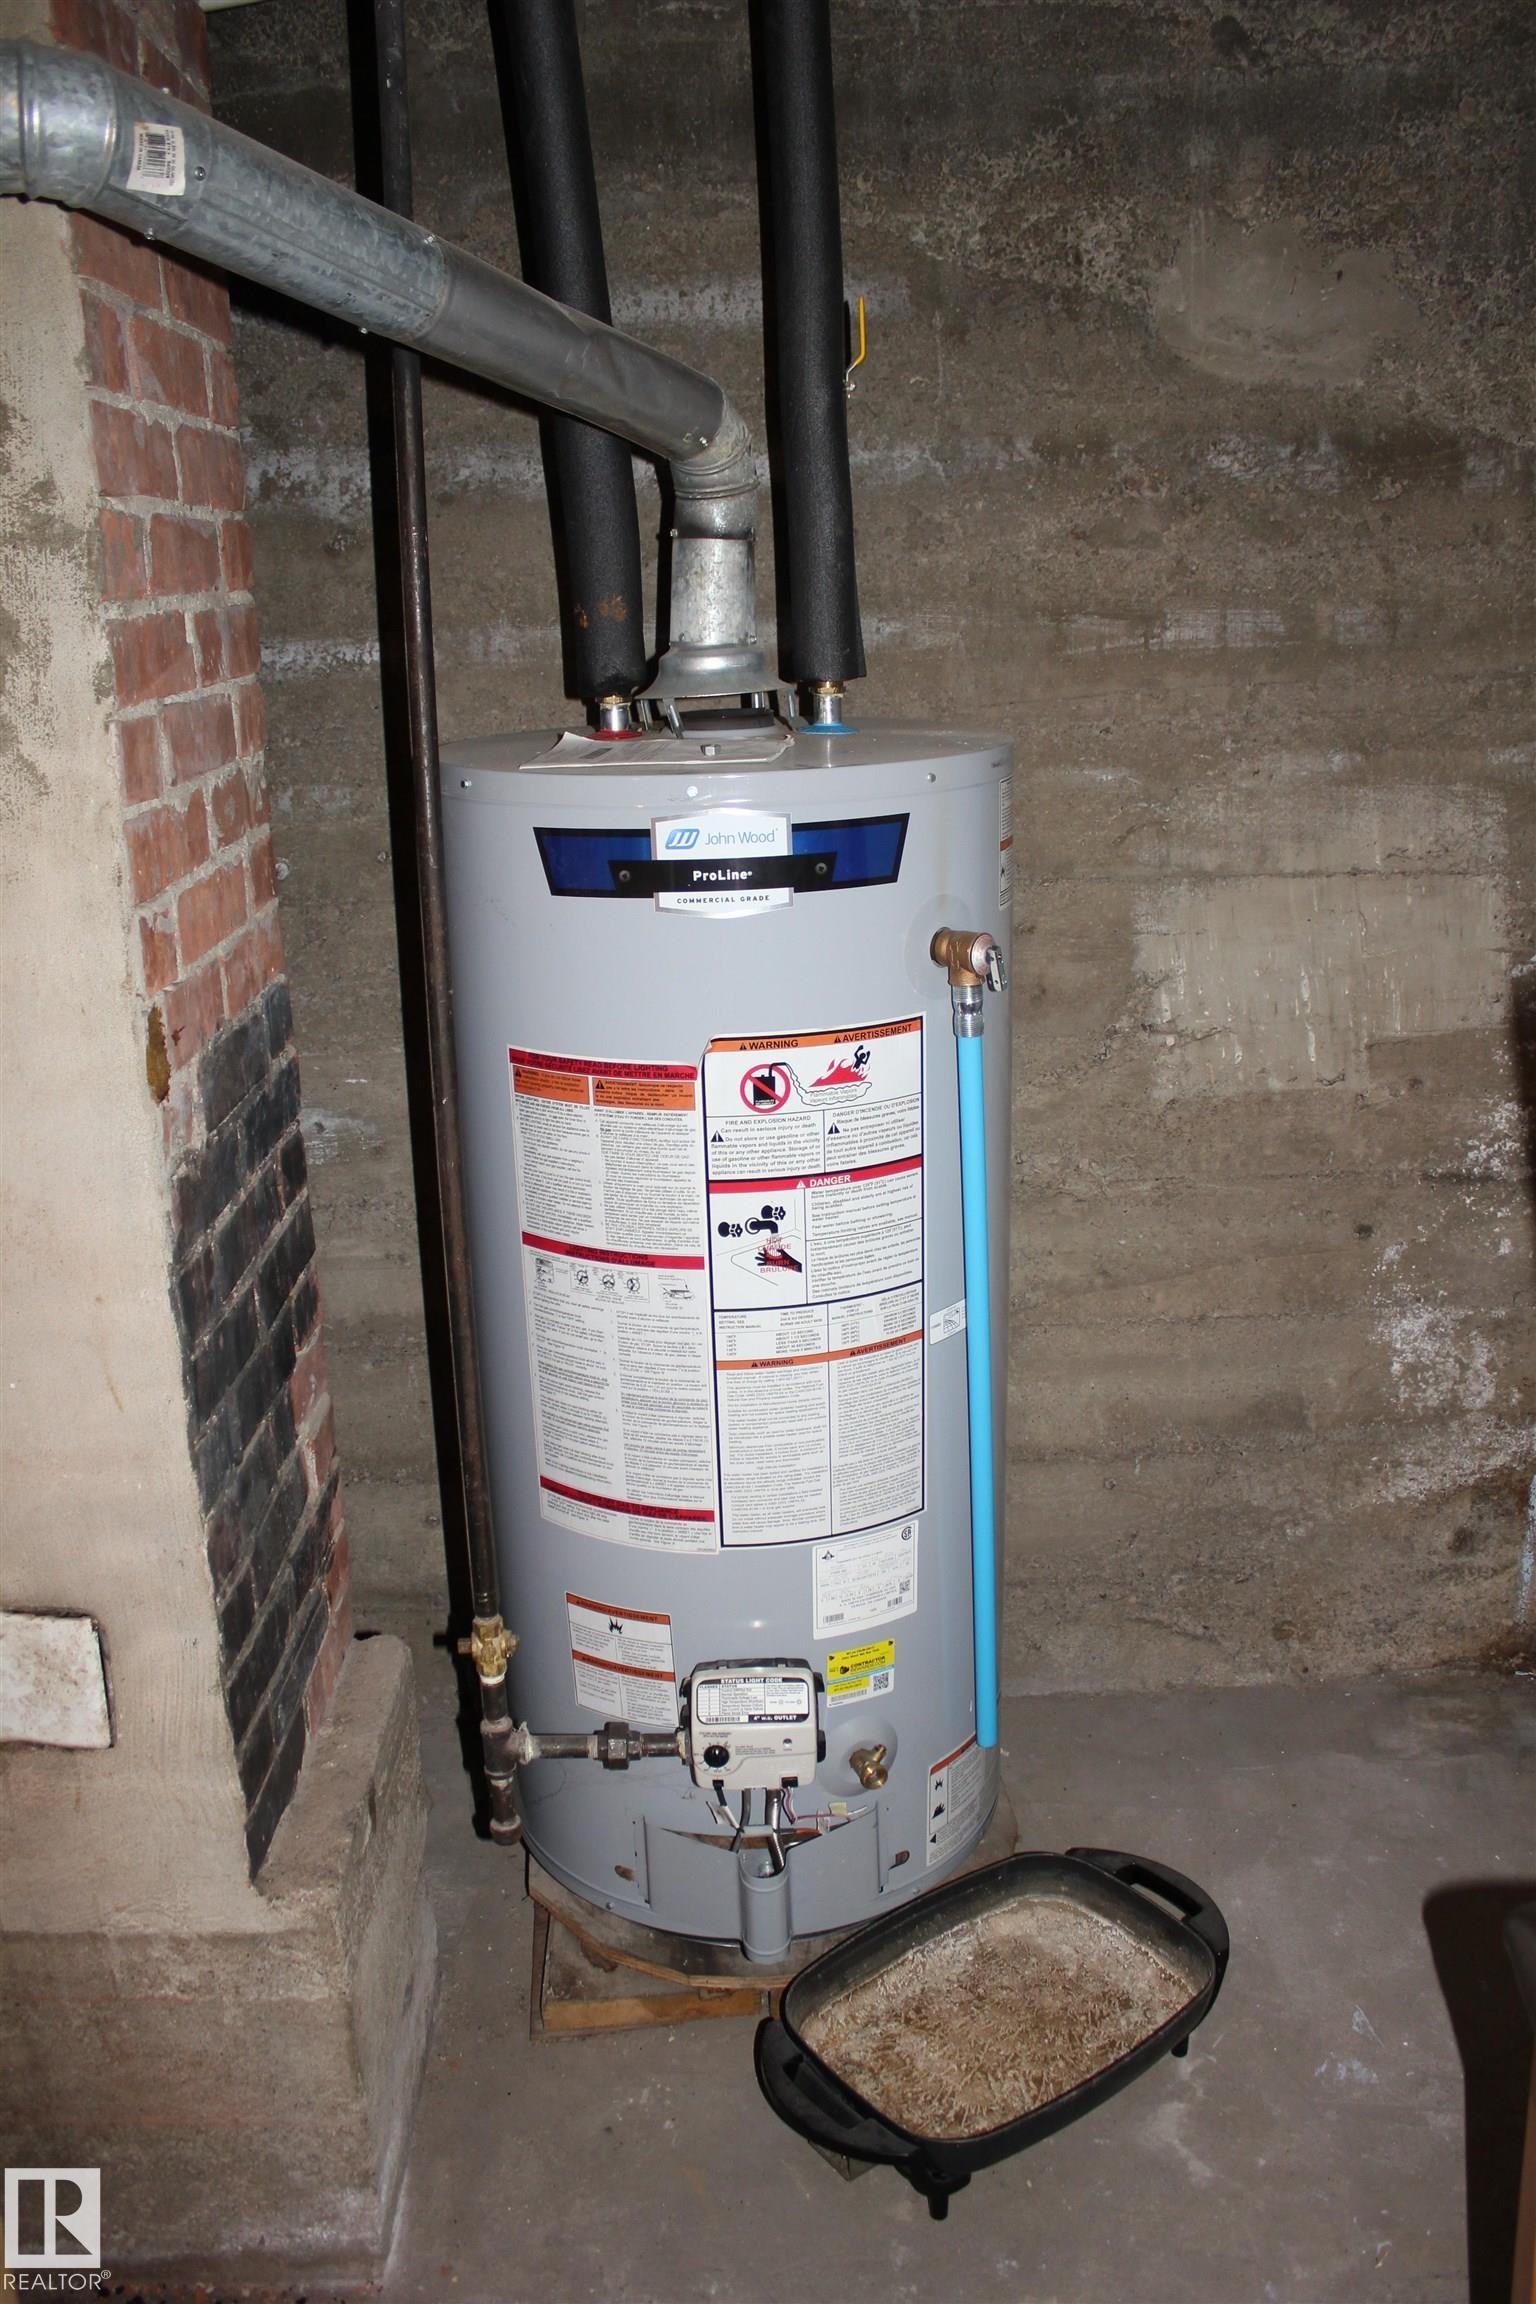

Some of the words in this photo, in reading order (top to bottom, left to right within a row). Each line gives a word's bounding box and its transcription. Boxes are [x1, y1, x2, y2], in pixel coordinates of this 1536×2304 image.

[705, 832, 735, 846] John
[738, 830, 776, 844] Wood
[749, 1039, 798, 1050] WARNING
[842, 1024, 912, 1043] AVERTISSEMENT
[624, 1070, 650, 1078] METTRE
[810, 1175, 851, 1187] DANGER
[760, 1359, 794, 1367] WARNING
[854, 1337, 907, 1355] AVERTISSEMENT
